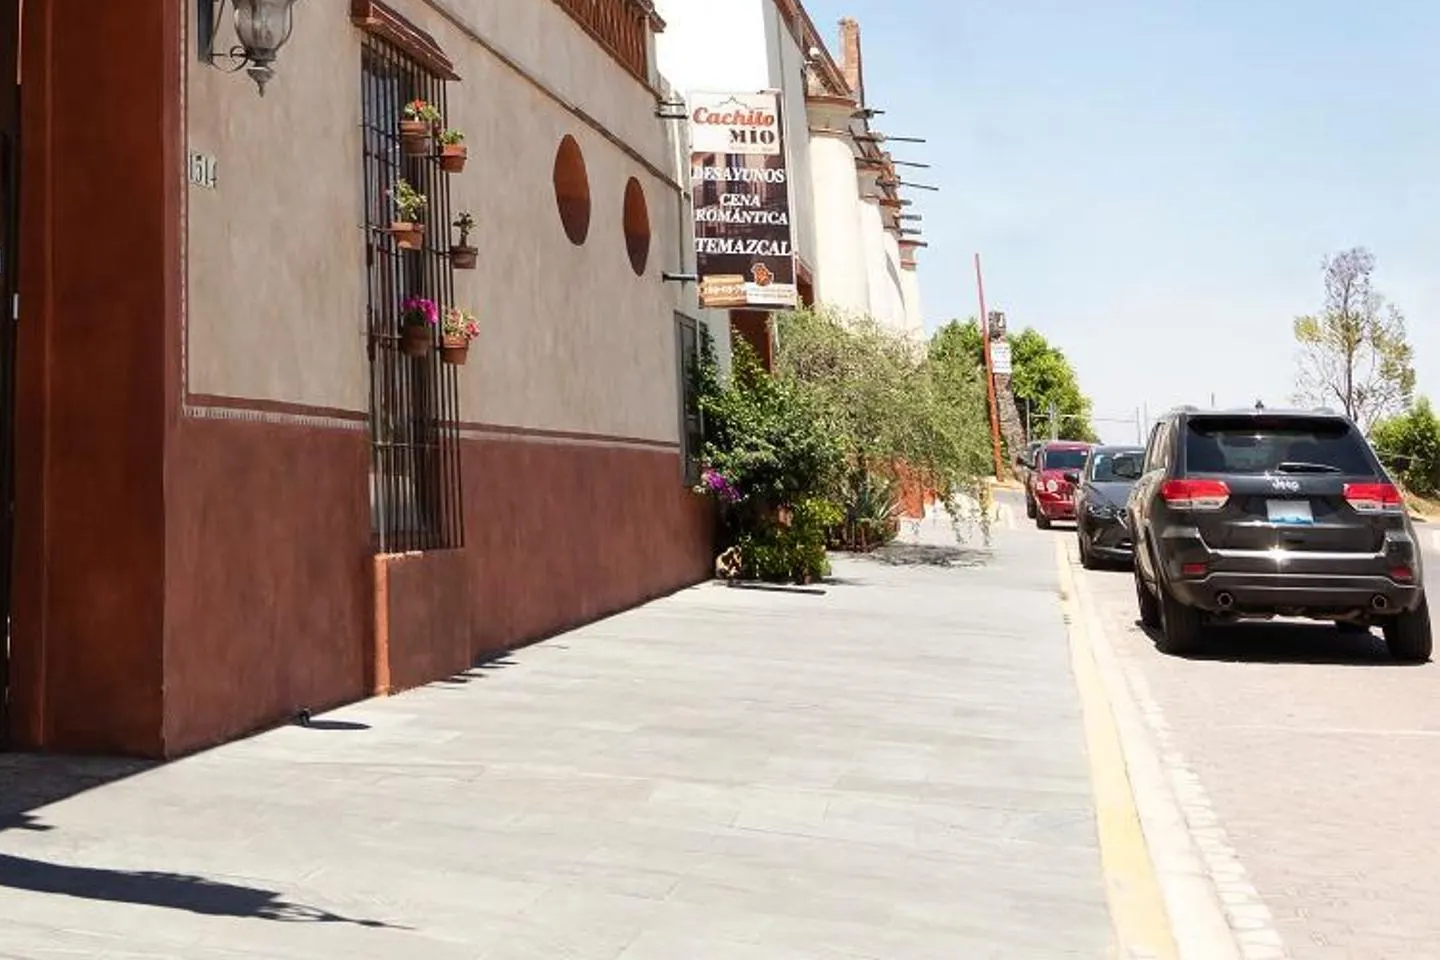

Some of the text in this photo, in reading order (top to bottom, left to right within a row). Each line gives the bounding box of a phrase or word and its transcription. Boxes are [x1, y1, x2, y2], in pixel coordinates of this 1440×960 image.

[692, 106, 775, 127] Cachito
[691, 166, 785, 184] DESAYUNOS
[719, 193, 761, 208] CENA
[695, 207, 789, 226] ROMÁNTICA
[694, 237, 793, 257] TEMAZCAL
